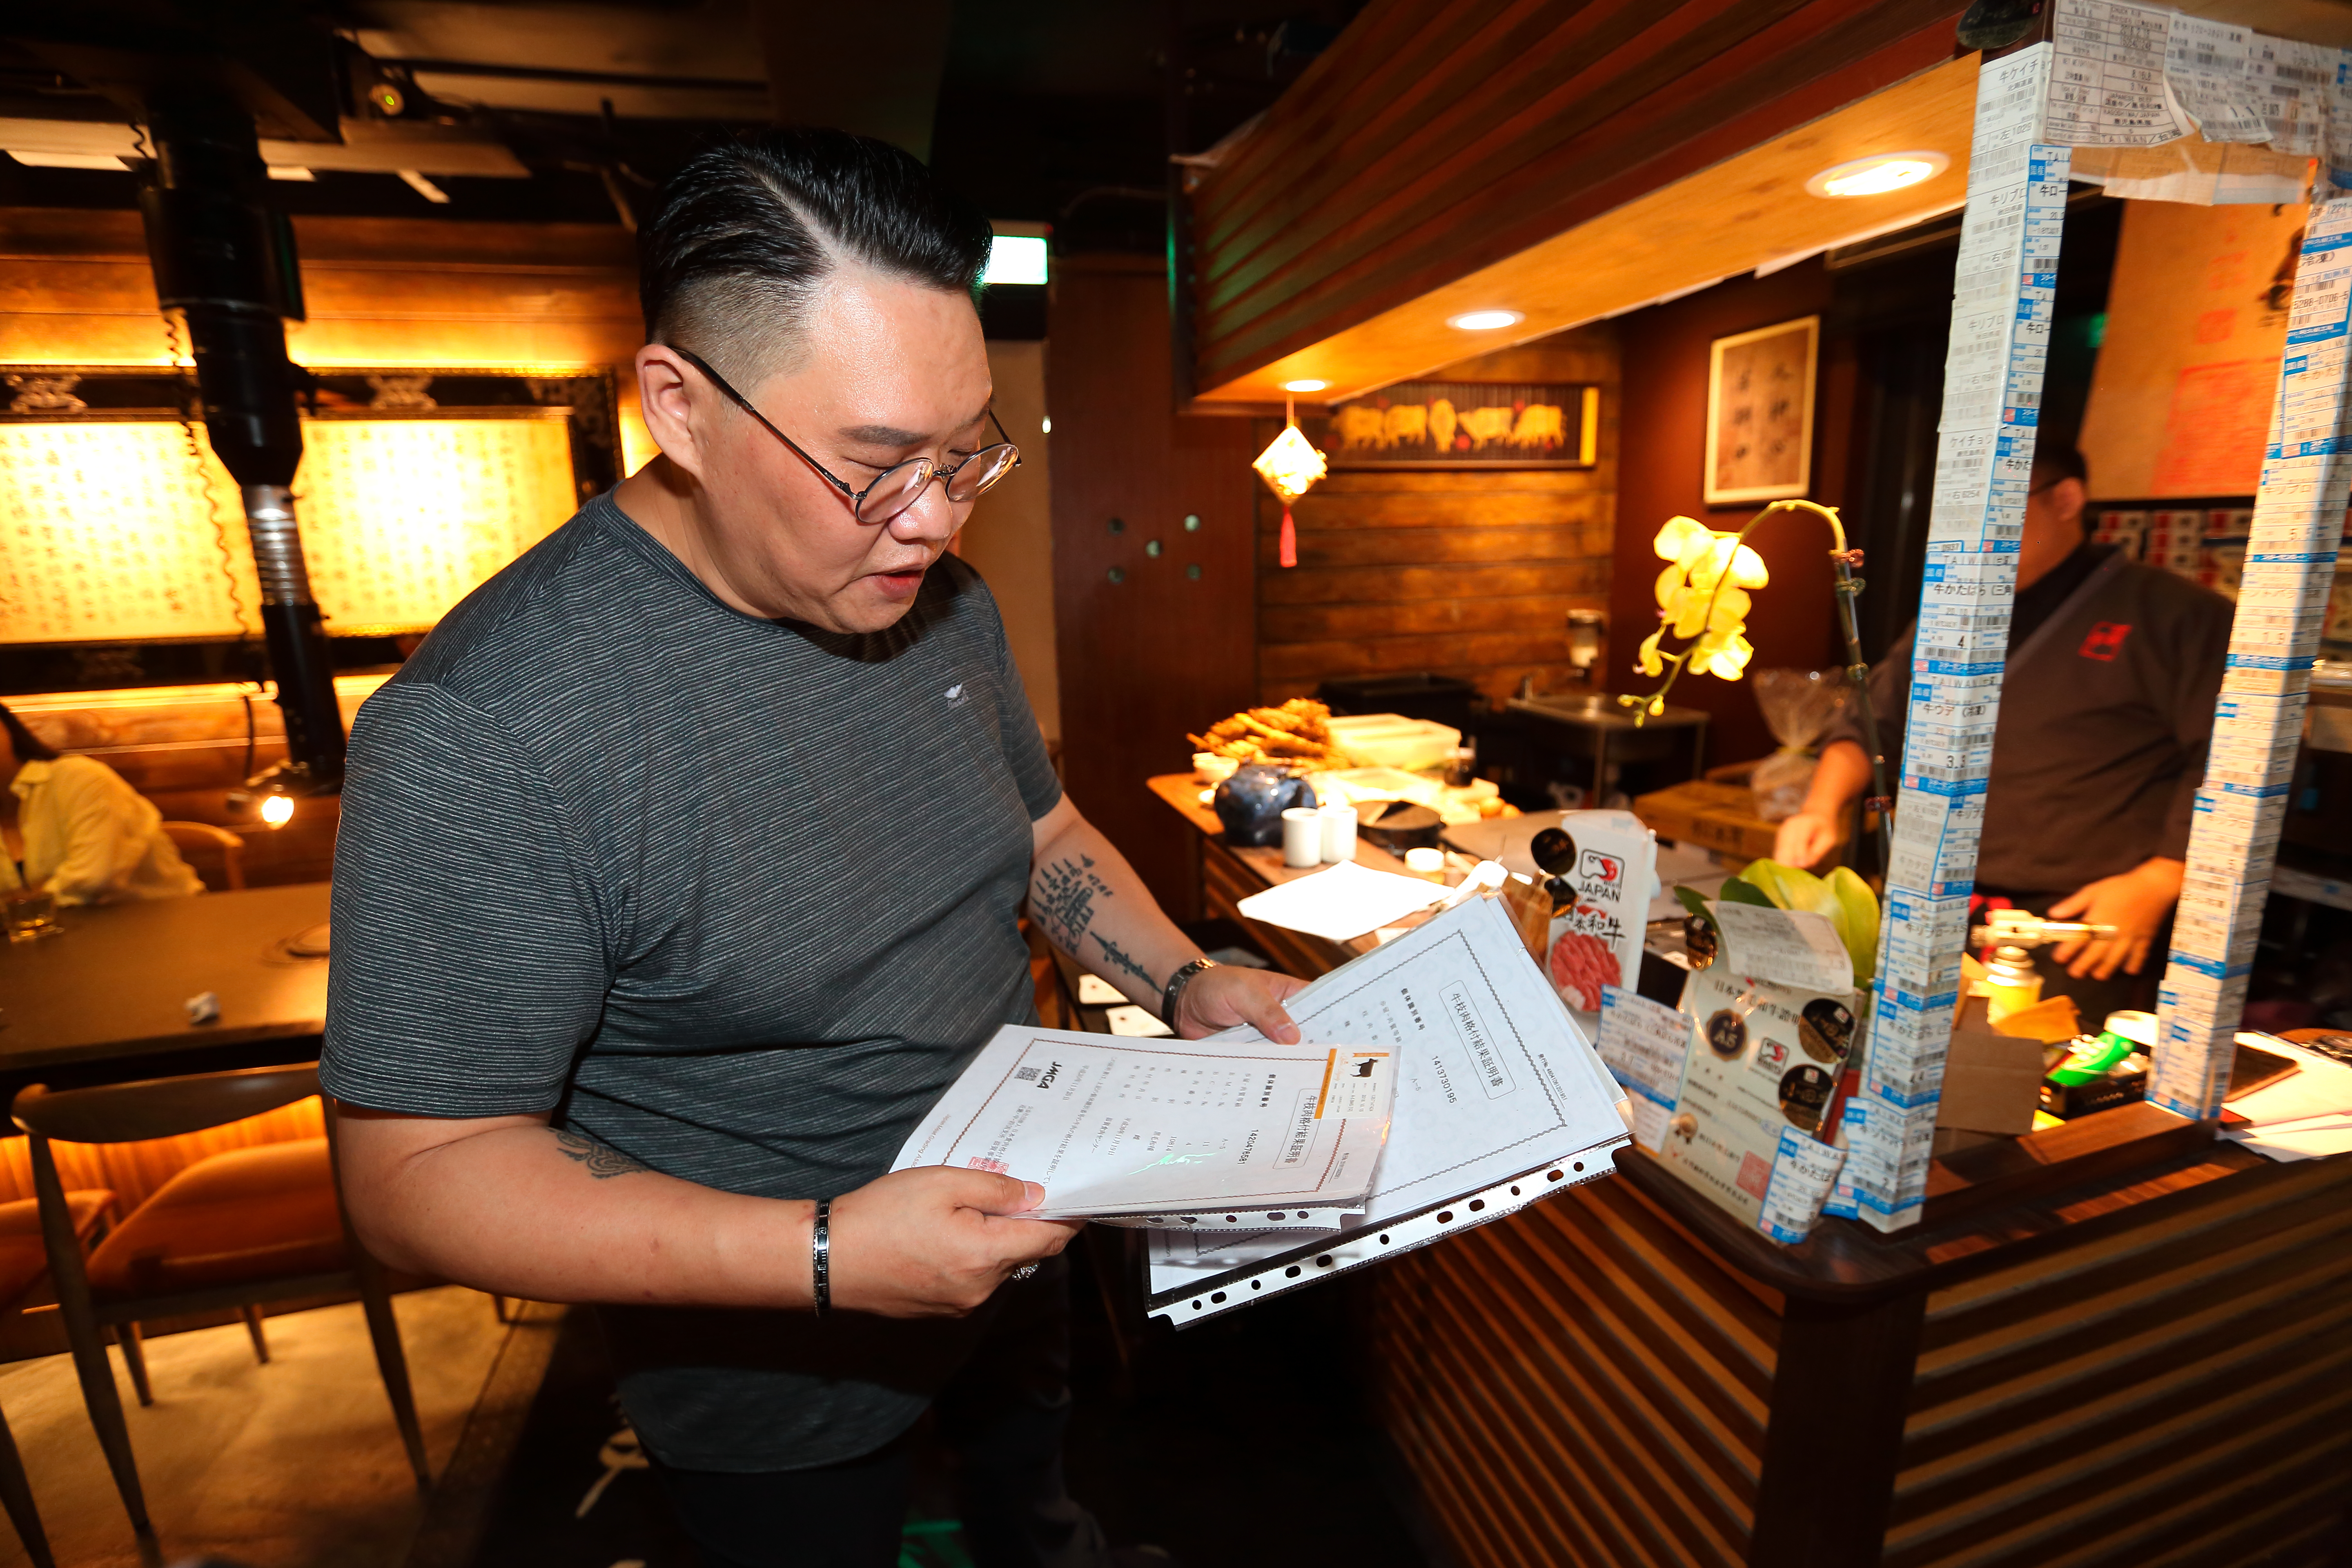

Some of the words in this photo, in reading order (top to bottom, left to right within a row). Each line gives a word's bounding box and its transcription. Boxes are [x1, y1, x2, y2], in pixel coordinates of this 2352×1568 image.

[1579, 880, 1621, 903] JAPAN
[1401, 987, 1425, 1031] 個体識別番号
[1451, 993, 1504, 1087] 牛枝肉格付結果証明書
[1036, 1061, 1062, 1089] JMGA
[1432, 1056, 1457, 1104] 1413730195
[918, 1135, 935, 1154] Grading
[1237, 1129, 1259, 1165] 1420476581
[1284, 1095, 1318, 1164] 牛枝肉格付結果証明書
